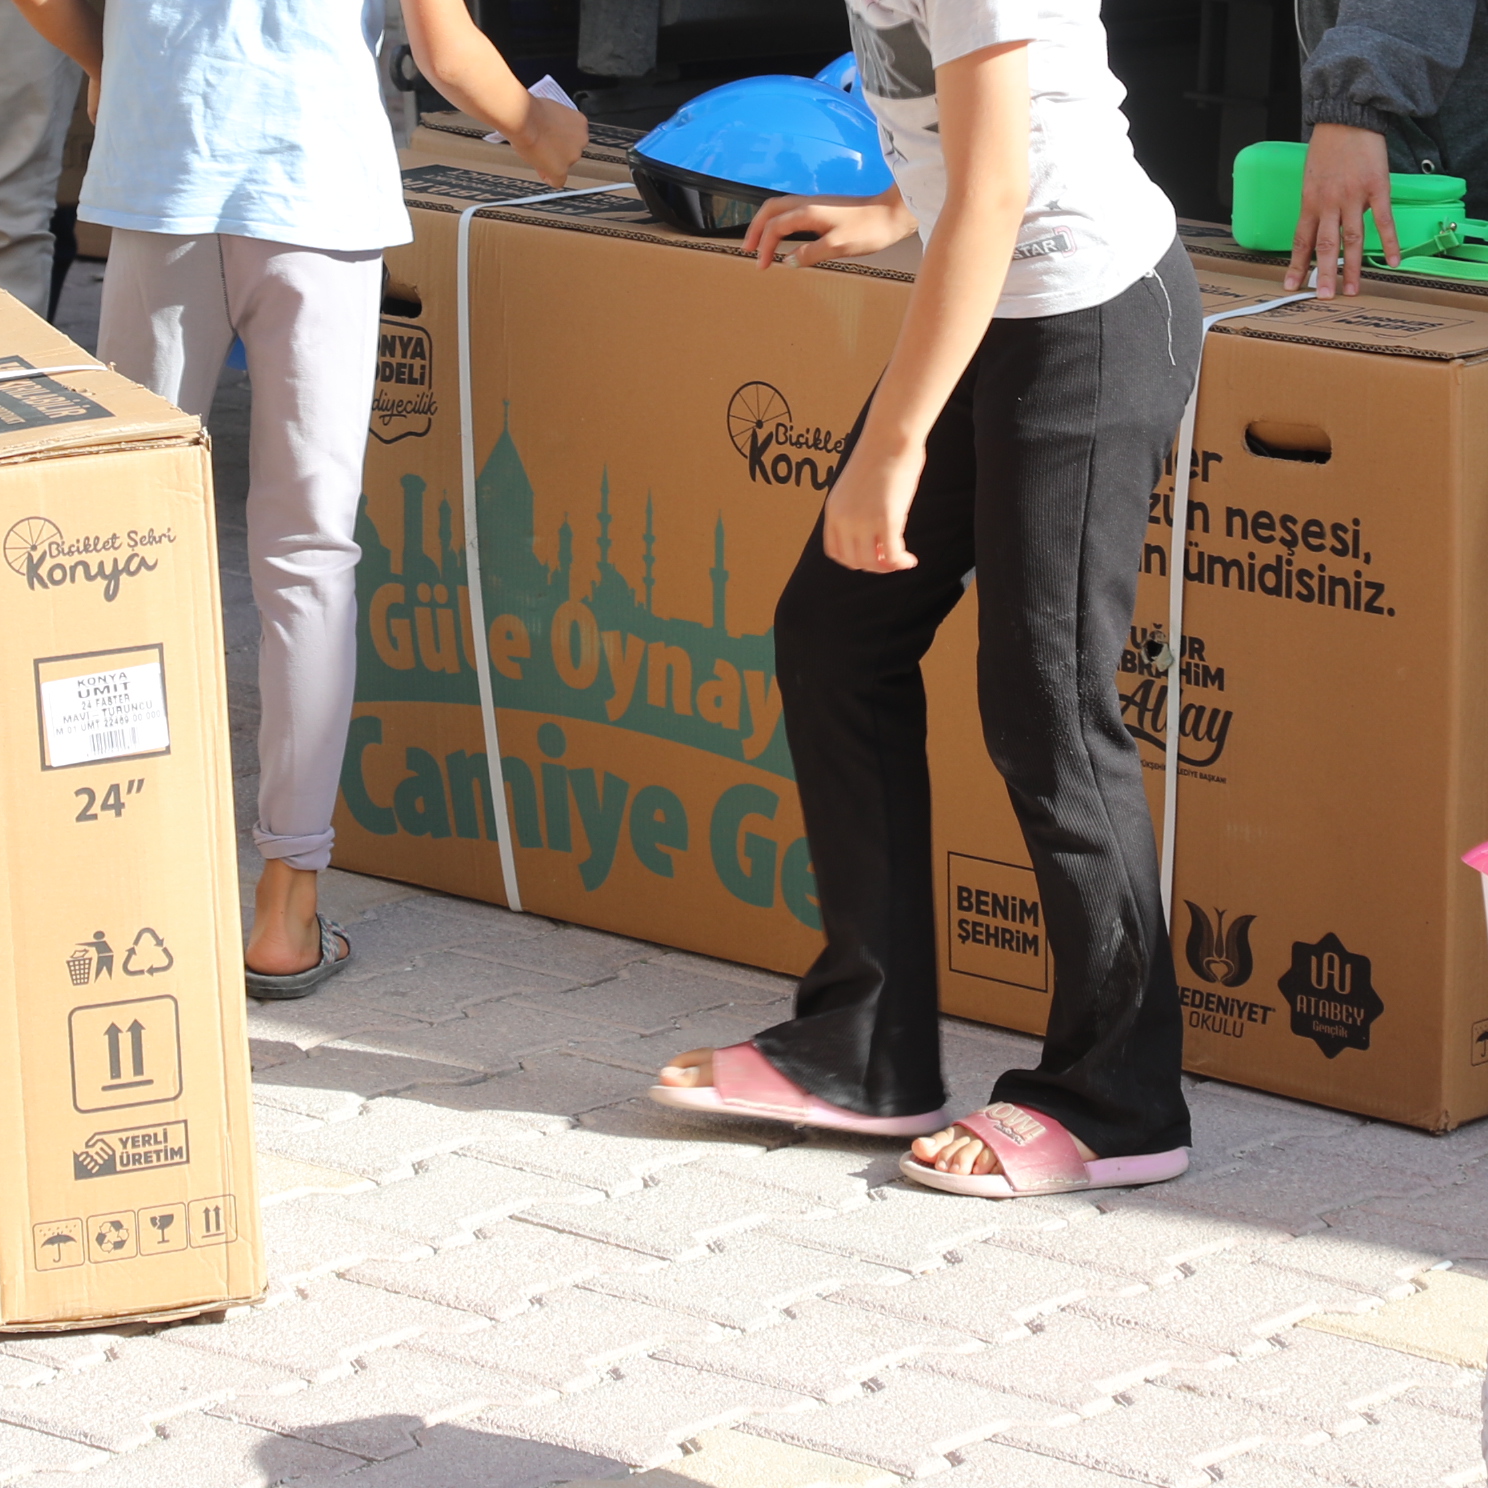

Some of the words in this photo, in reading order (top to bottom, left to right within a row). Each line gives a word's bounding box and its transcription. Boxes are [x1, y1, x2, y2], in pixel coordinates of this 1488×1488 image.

[378, 333, 426, 361] NYA
[376, 360, 426, 386] DELİ
[372, 388, 458, 426] diyecilik
[48, 532, 123, 559] Bisiklet
[126, 527, 177, 552] Şehri
[1225, 504, 1372, 566] neşesi,
[26, 549, 159, 603] Konya
[1183, 541, 1396, 618] ümidisiniz.
[77, 671, 128, 687] KONYA
[368, 582, 532, 680] Güle
[550, 599, 783, 761] Oynay
[81, 701, 91, 711] 24
[339, 715, 689, 893] Camiye
[709, 782, 826, 932] Ge
[955, 883, 1041, 929] BENİM
[956, 916, 1041, 958] ŞEHRİM
[1176, 985, 1270, 1026] EDENİYET
[1296, 993, 1366, 1027] ATABEY
[1188, 1009, 1245, 1040] OKULU
[118, 1127, 169, 1151] YERLİ
[118, 1145, 184, 1169] ÜRETİM
